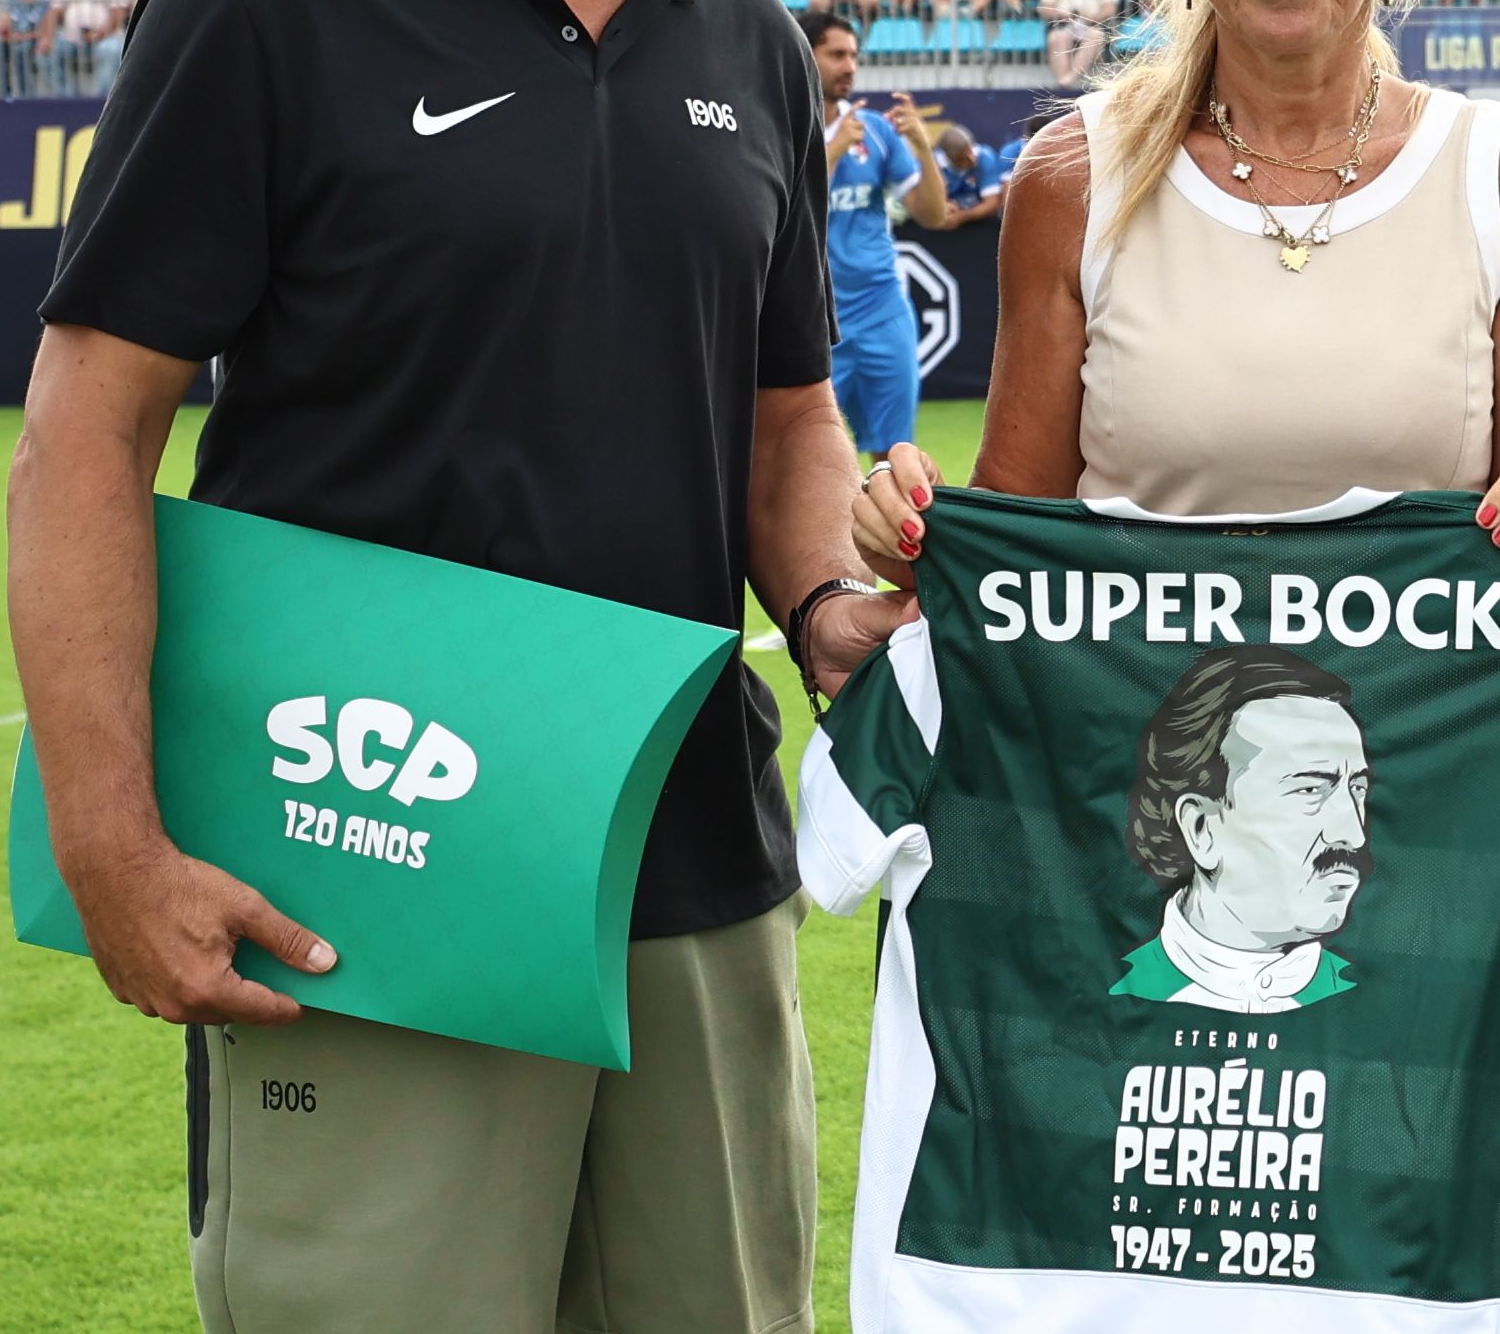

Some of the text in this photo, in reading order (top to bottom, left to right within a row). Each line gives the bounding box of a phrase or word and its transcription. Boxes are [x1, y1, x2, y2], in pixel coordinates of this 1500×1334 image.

[1425, 36, 1485, 70] LIGA
[684, 98, 738, 132] 1906
[977, 569, 1246, 644] SUPER
[266, 695, 478, 807] SCP
[284, 799, 431, 870] 120 ANOS
[1174, 1030, 1279, 1050] ETERNO
[260, 1079, 317, 1113] 1906
[1120, 1058, 1327, 1130] AURÉLIO
[1113, 1125, 1324, 1192] PEREIRA
[1112, 1195, 1318, 1223] SR. FORMAÇÃO
[1110, 1225, 1192, 1272] 1947
[1218, 1229, 1317, 1279] 2025
